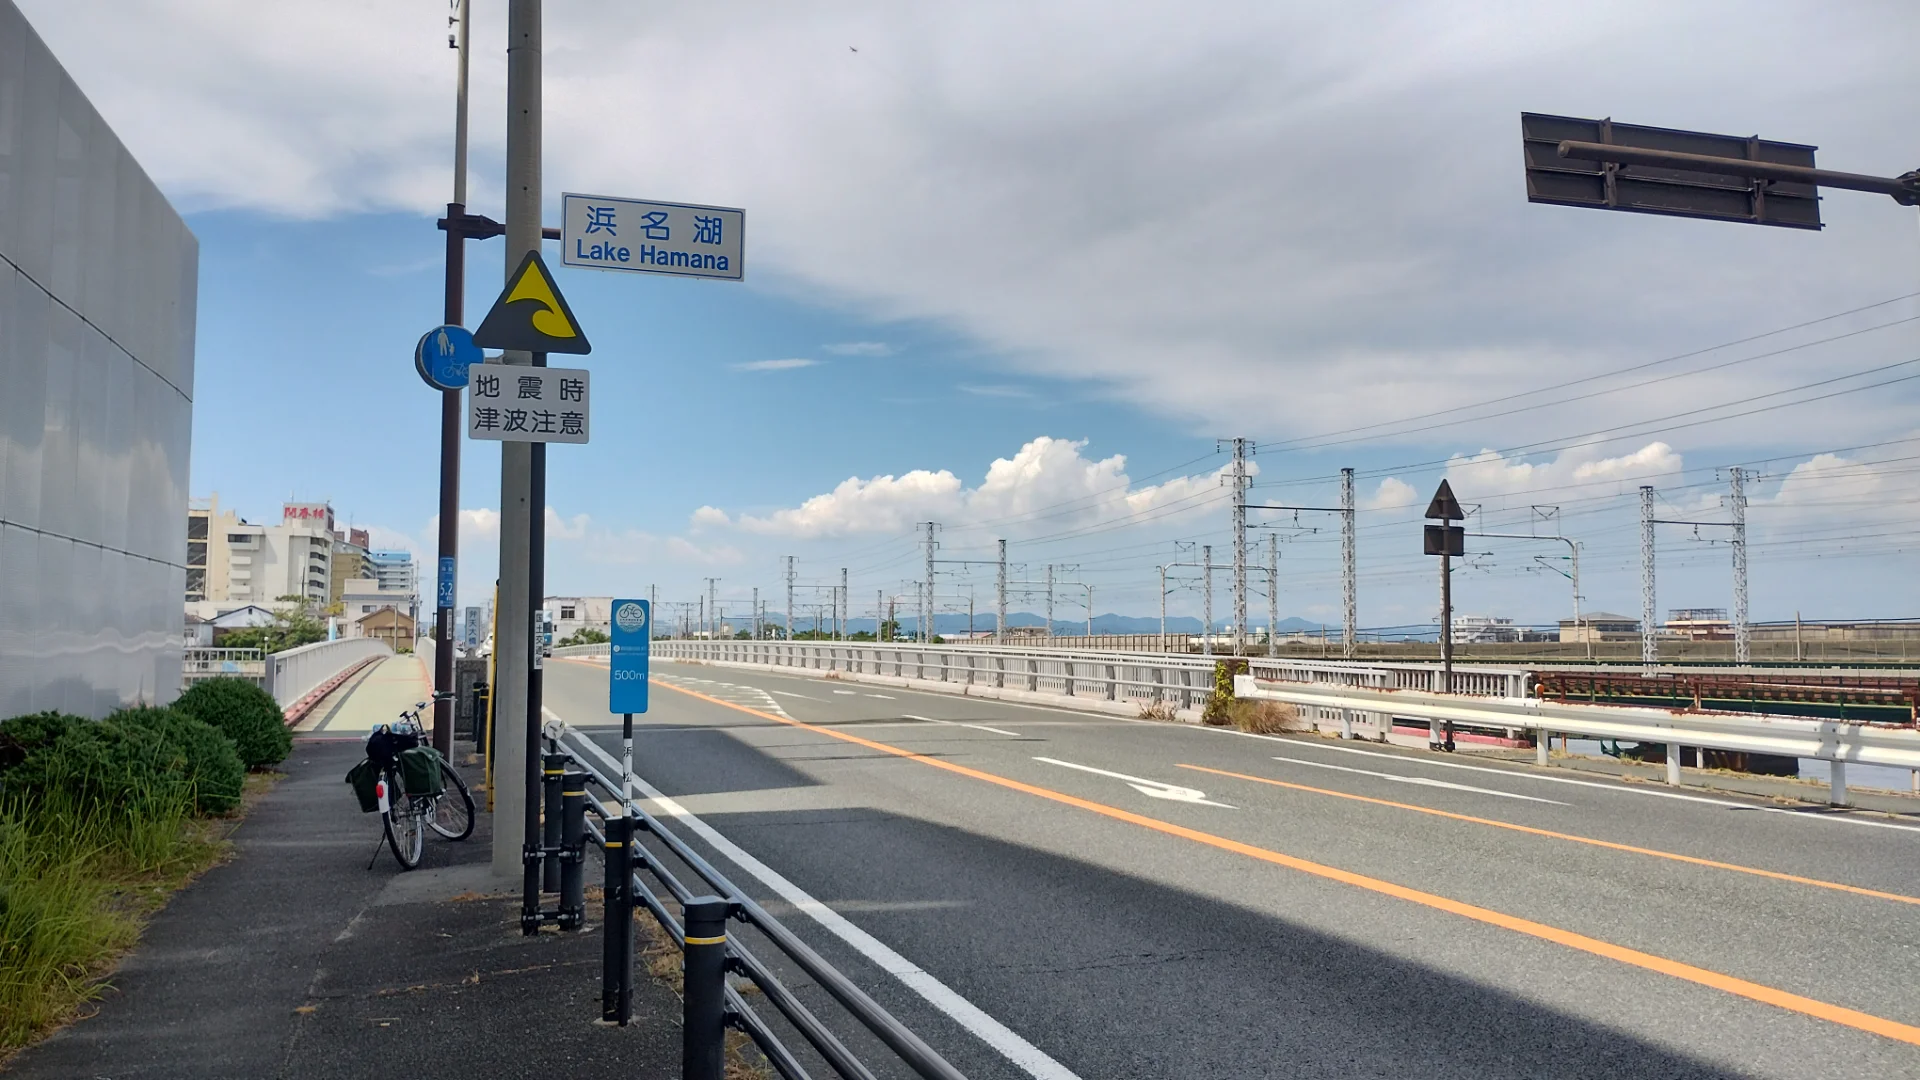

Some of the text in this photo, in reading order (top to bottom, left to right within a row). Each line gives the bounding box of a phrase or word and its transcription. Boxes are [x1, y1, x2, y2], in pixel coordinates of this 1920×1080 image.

[585, 205, 723, 245] 浜名湖
[576, 239, 729, 271] Lake Hamana
[475, 374, 585, 402] 地震時
[474, 406, 585, 436] 津波注意
[440, 582, 453, 596] 5.2
[614, 670, 645, 680] 500m
